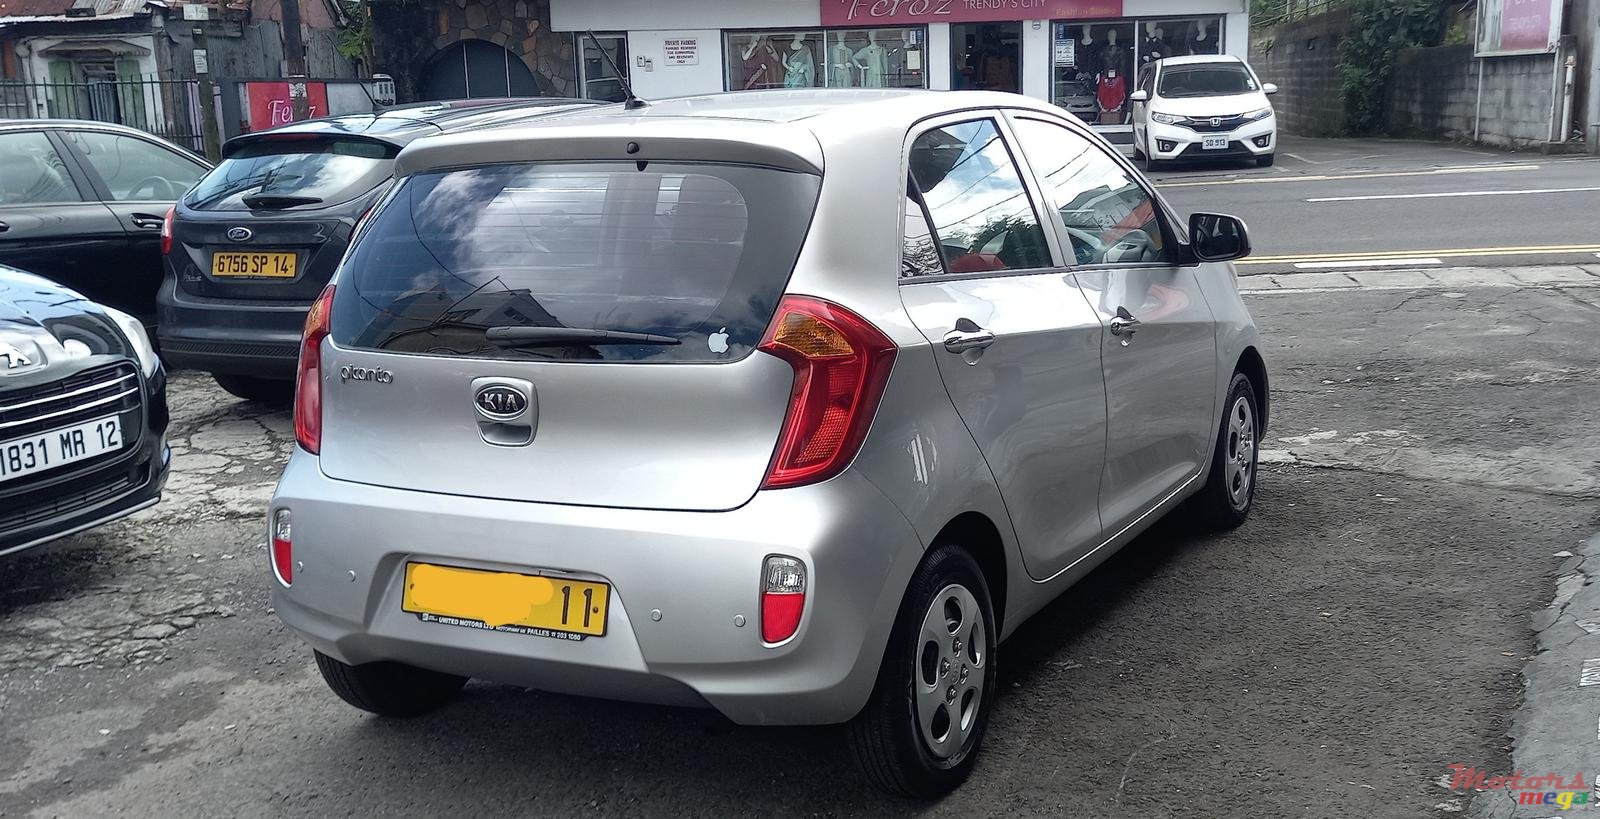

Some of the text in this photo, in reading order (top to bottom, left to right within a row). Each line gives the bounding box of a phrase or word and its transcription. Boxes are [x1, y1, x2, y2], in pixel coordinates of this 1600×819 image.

[1021, 0, 1047, 8] CITY
[217, 255, 289, 274] 6756 SP 14
[483, 393, 519, 411] KIA
[60, 429, 86, 460] MR
[96, 420, 118, 449] 12
[561, 585, 593, 628] 11
[438, 616, 459, 626] UNITED
[459, 619, 483, 629] MOTORS
[526, 629, 550, 637] PAILLES
